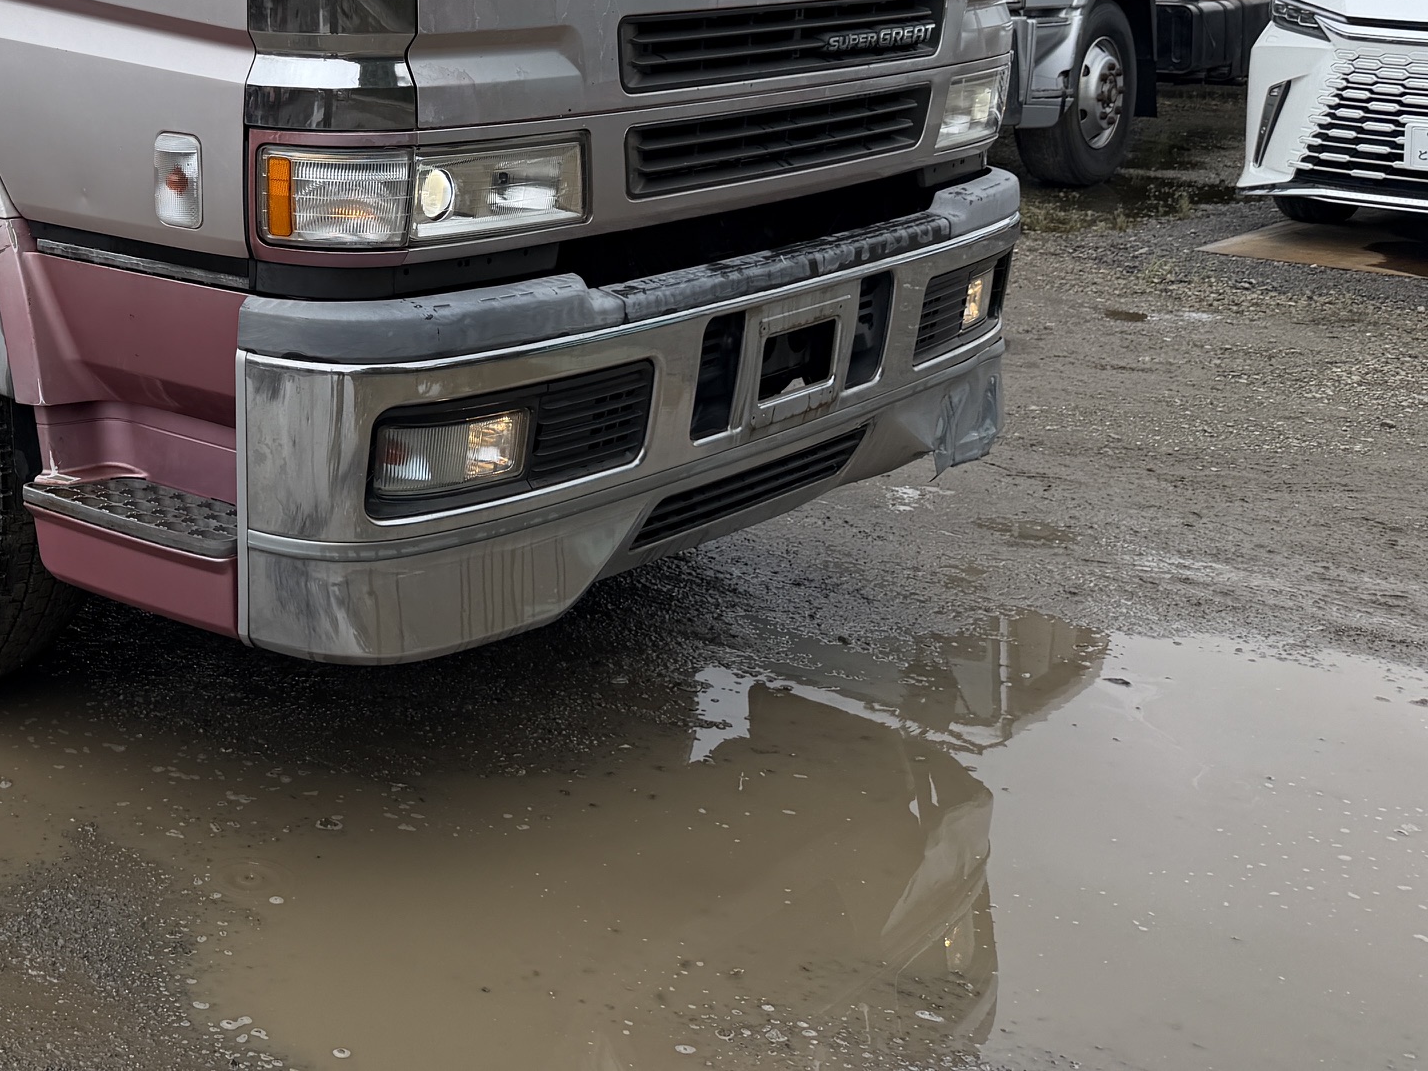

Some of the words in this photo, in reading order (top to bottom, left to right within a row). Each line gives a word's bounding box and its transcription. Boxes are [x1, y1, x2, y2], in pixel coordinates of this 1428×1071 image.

[828, 32, 877, 51] SUPER
[879, 23, 936, 46] GREAT
[310, 222, 321, 237] 5
